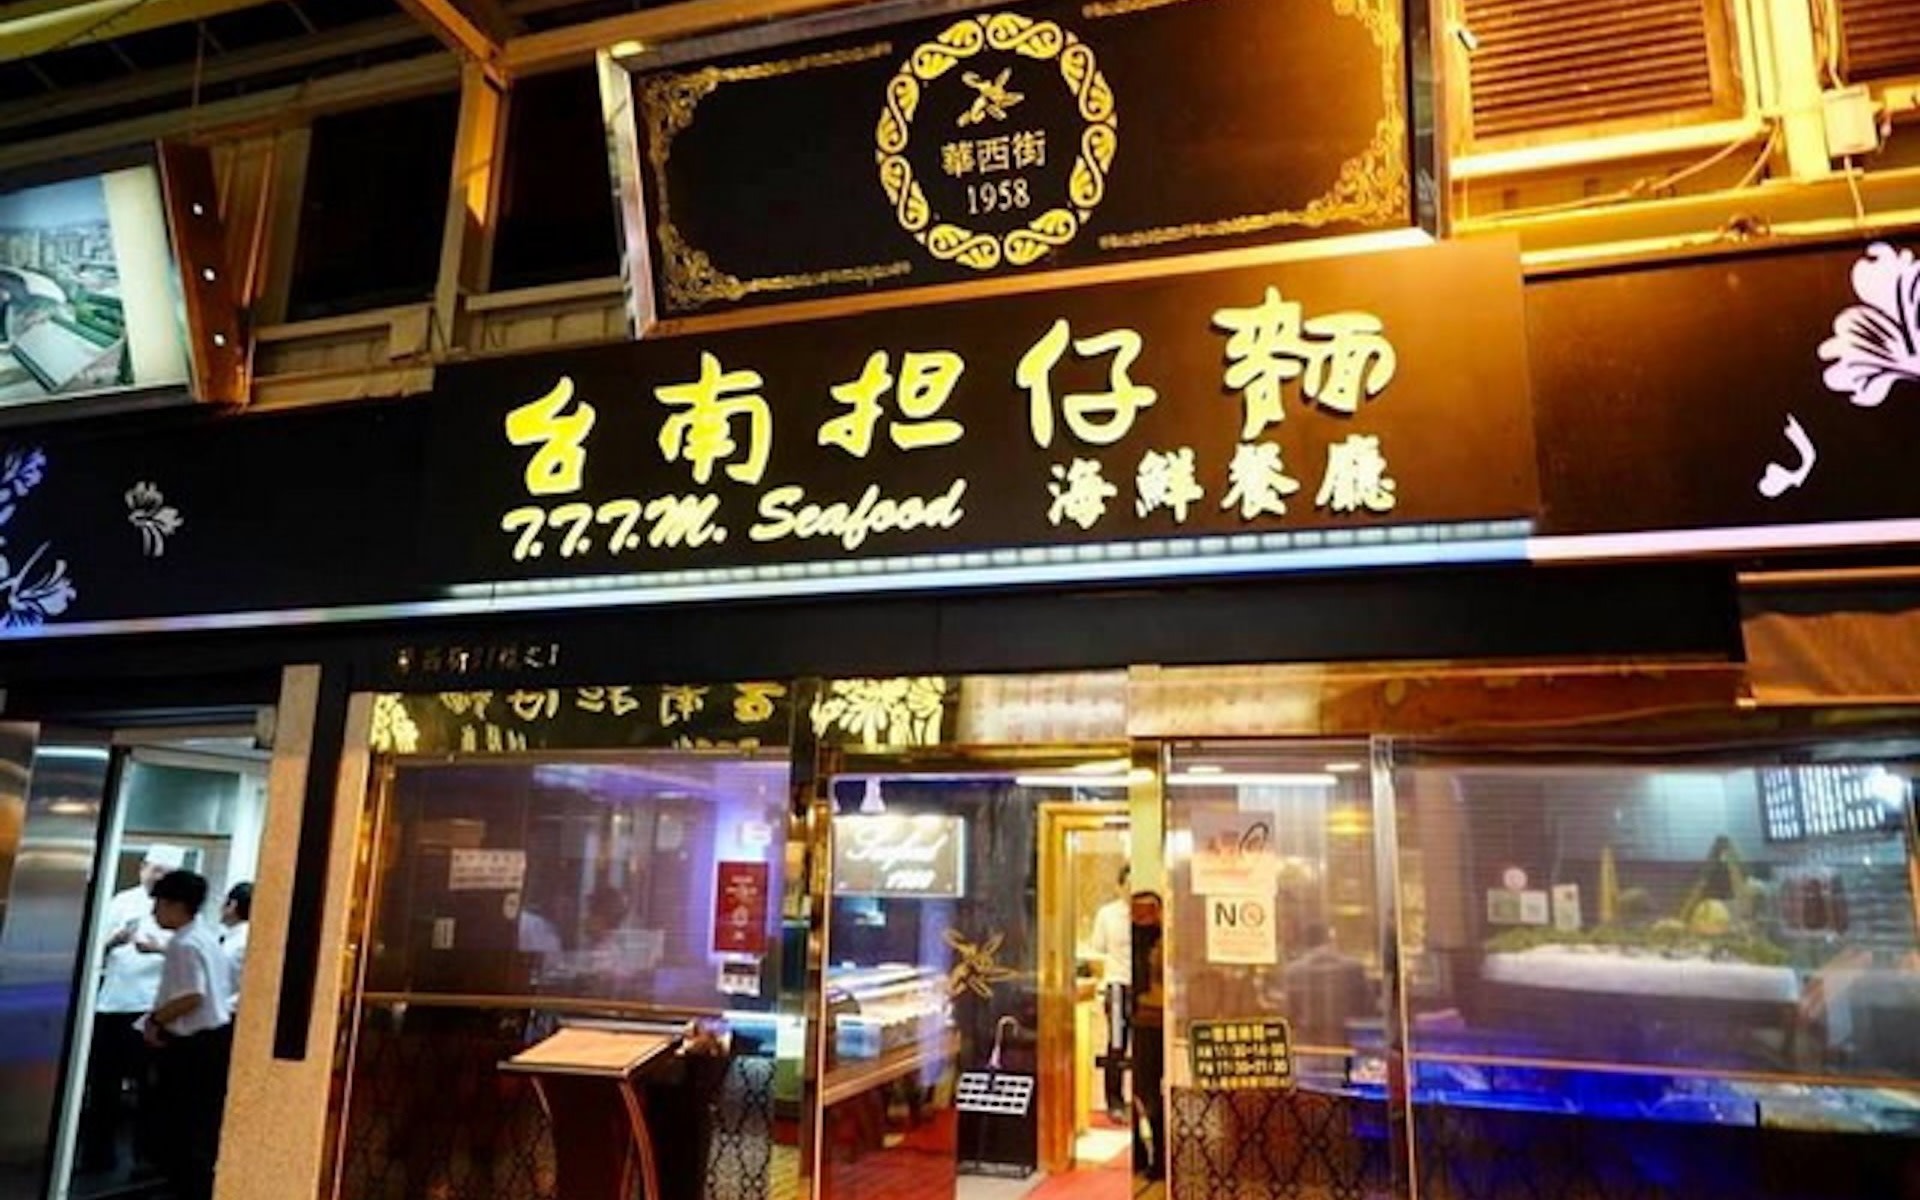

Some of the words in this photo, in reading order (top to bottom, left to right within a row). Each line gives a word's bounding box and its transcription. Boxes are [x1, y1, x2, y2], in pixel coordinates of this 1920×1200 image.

[941, 130, 1046, 178] 華西街
[967, 178, 1031, 215] 1958
[1048, 434, 1397, 530] 海鮮餐廳
[749, 478, 967, 550] Seafood
